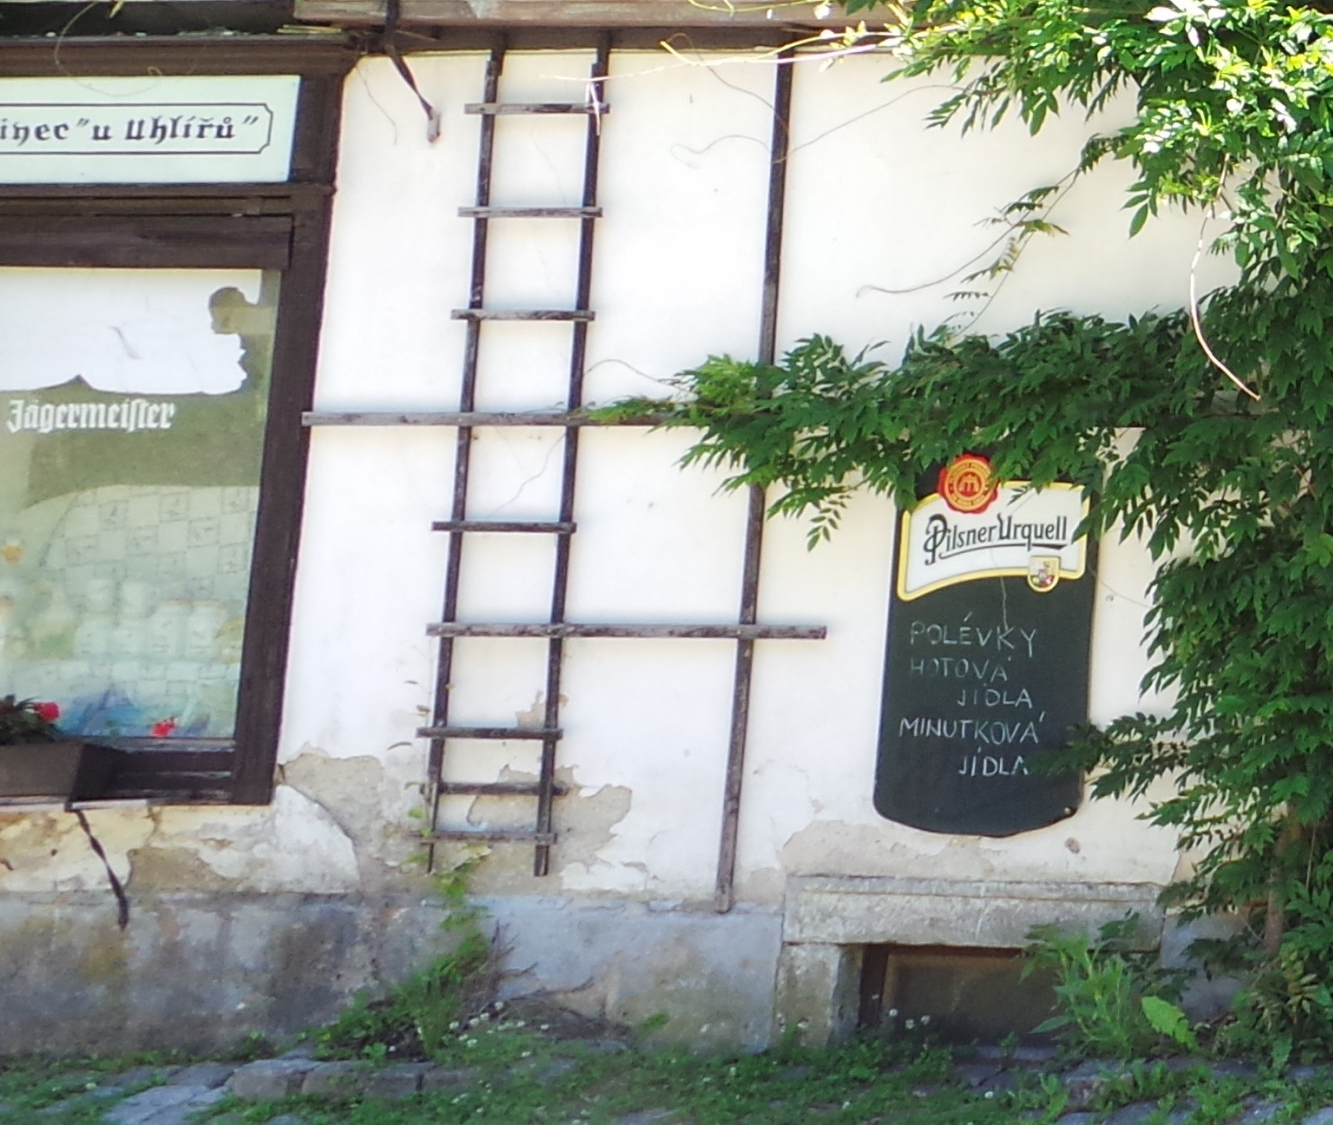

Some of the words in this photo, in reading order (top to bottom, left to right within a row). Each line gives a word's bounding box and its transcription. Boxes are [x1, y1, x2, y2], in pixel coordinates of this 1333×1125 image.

[923, 514, 998, 565] Pilsner
[997, 512, 1067, 551] Urquell
[910, 611, 1036, 657] POLÉVKY
[899, 711, 1045, 744] MINUTKOVÁ
[958, 746, 1029, 776] JÍDLA
